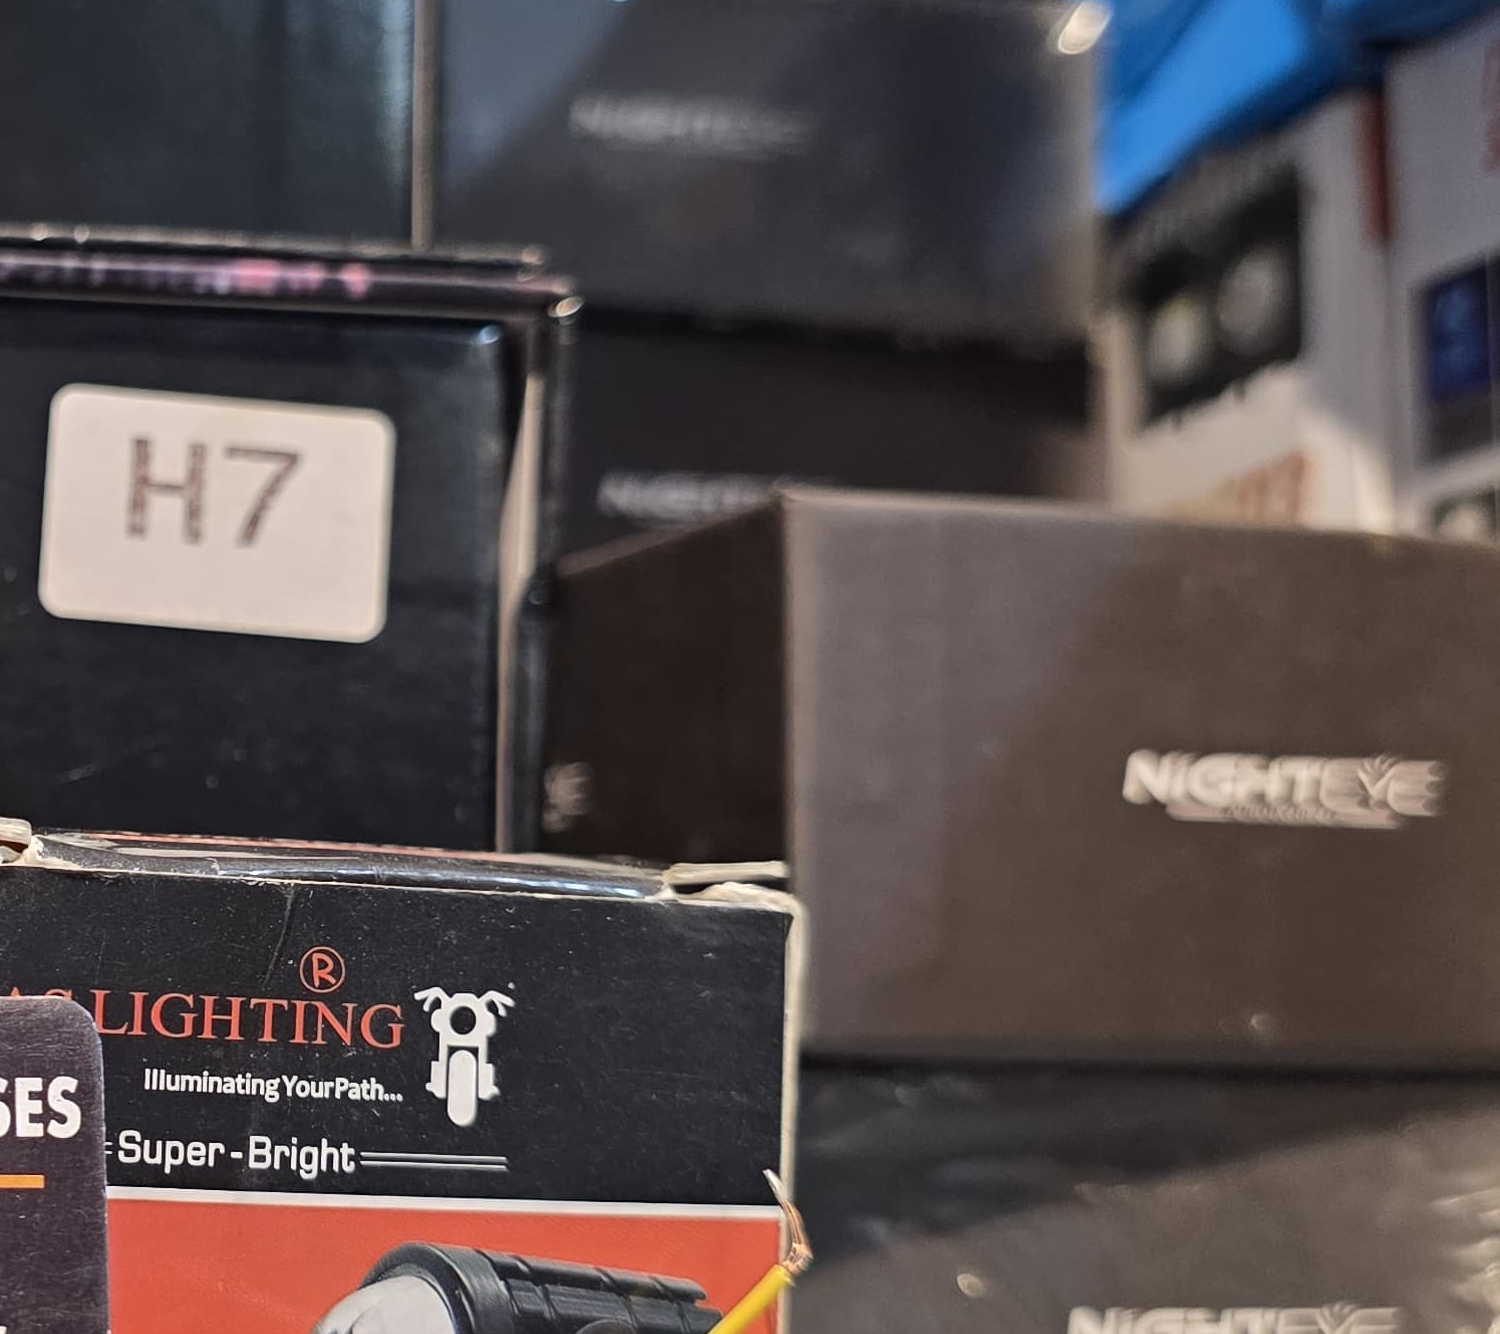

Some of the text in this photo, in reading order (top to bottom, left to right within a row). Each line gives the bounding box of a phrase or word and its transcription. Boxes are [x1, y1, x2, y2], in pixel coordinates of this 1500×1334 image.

[127, 437, 302, 548] H7
[1122, 749, 1446, 817] NIGHTEYE
[91, 988, 404, 1048] LIGHTING
[144, 1068, 281, 1103] Illuminating
